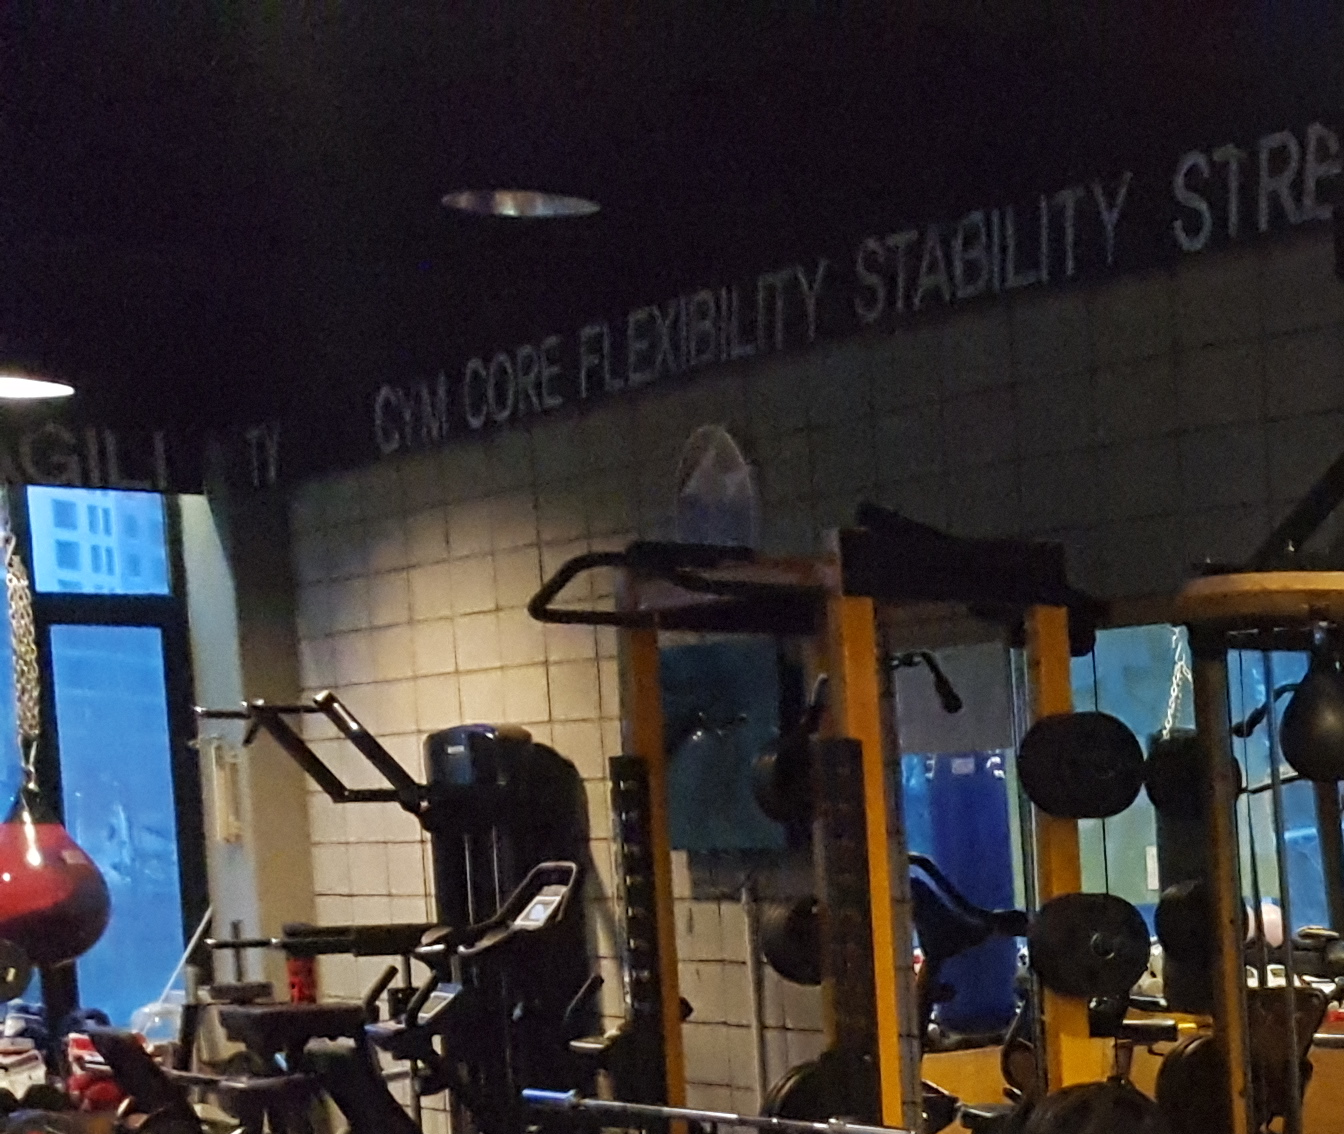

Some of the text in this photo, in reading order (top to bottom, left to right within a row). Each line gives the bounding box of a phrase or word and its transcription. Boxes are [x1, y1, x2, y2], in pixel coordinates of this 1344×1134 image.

[463, 335, 563, 429] CORE
[579, 256, 828, 399] FLEXIBILITY
[854, 170, 1134, 325] STABILITY
